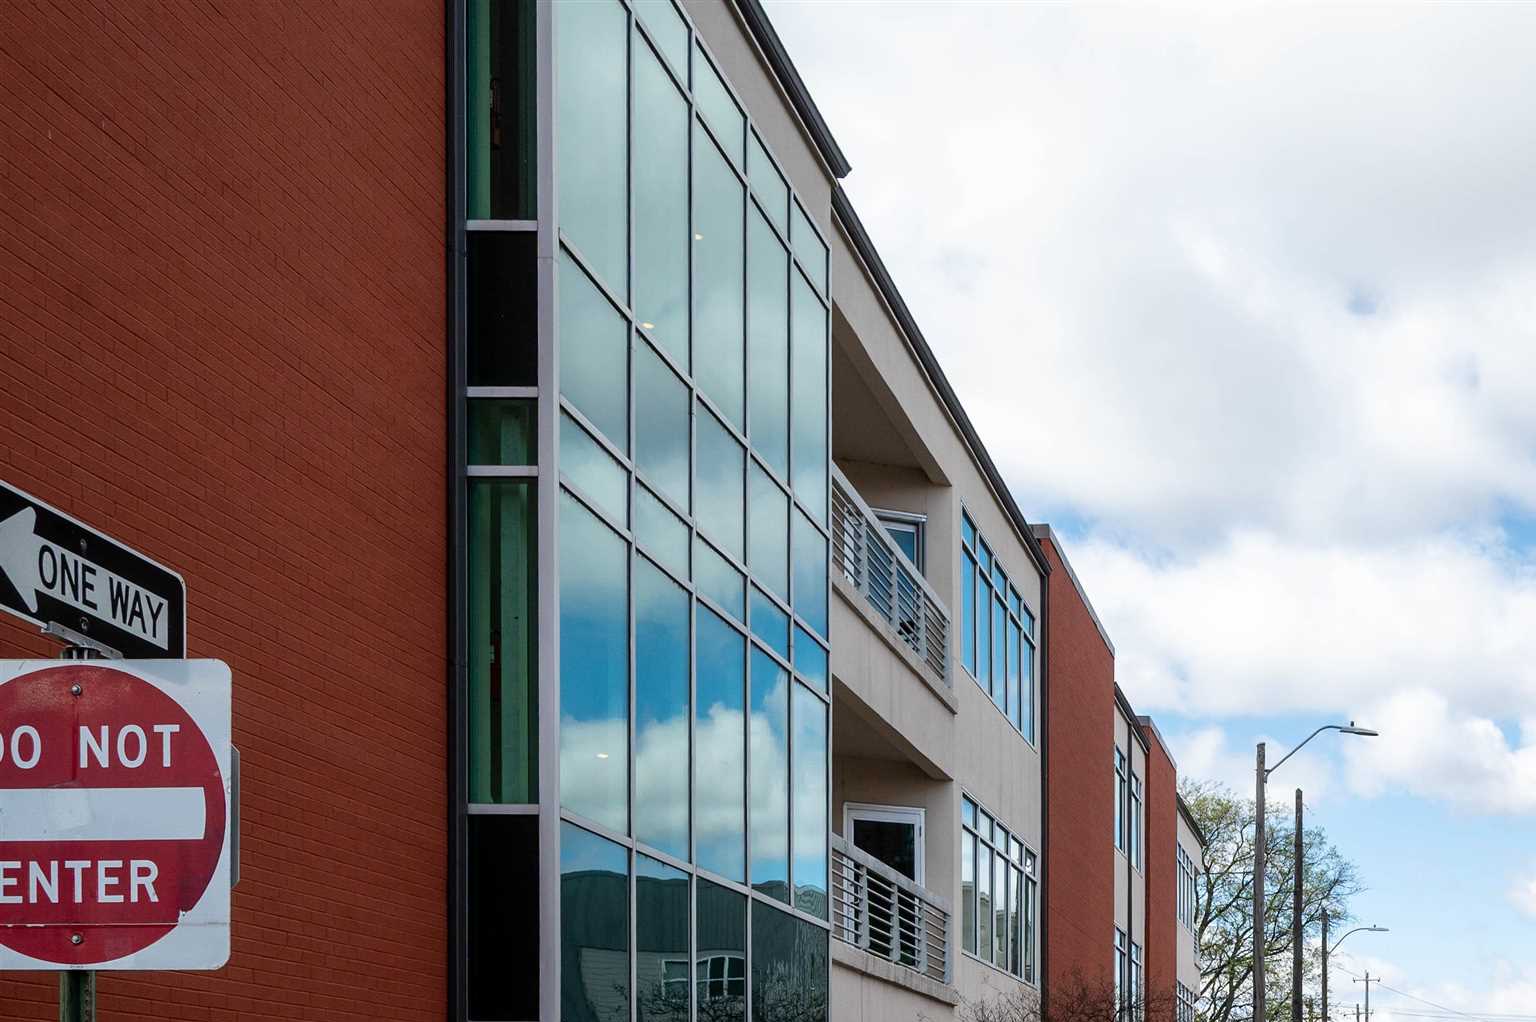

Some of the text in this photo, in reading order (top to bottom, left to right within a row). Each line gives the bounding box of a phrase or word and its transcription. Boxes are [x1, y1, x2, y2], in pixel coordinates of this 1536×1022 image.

[38, 544, 164, 639] ONE WAY
[0, 724, 181, 769] O NOT
[0, 859, 159, 904] ENTER
